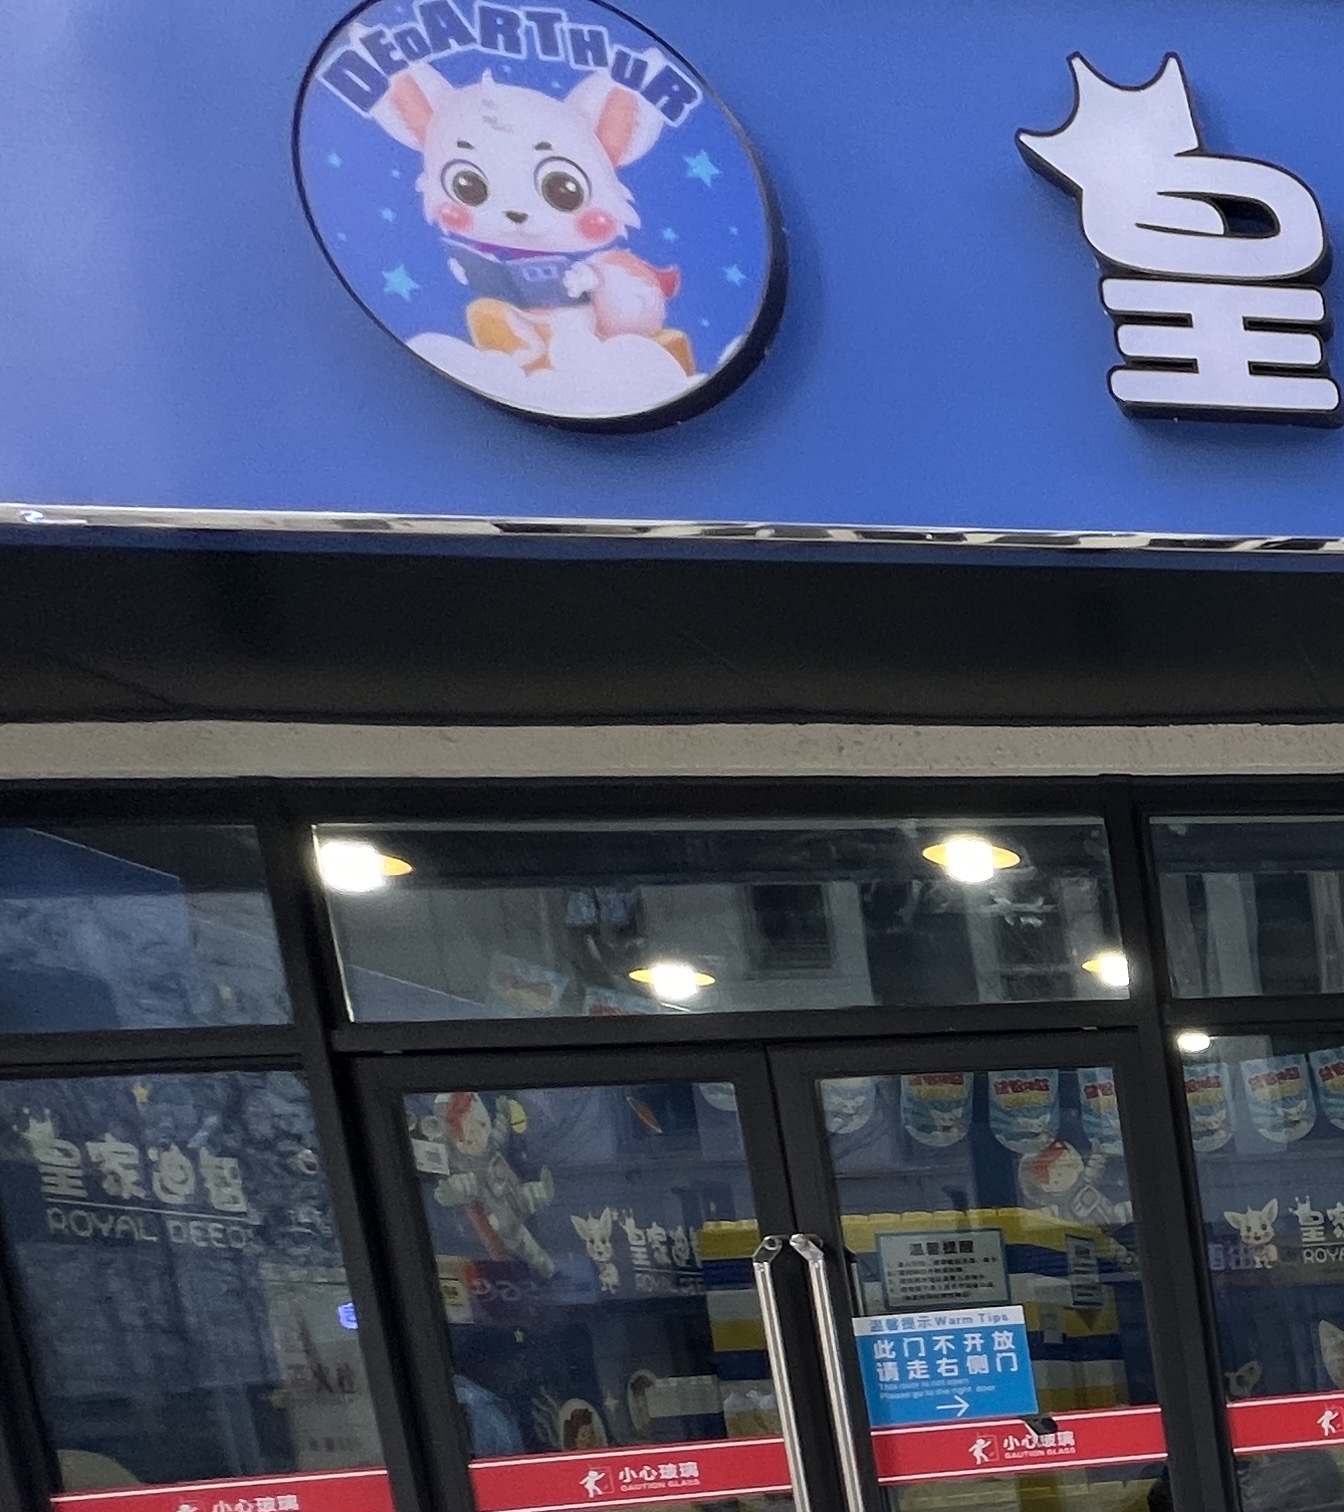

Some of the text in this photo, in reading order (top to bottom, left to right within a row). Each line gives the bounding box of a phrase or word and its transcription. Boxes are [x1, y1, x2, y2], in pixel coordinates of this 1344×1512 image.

[869, 1313, 1010, 1332] 温馨提示 Warm Tips
[873, 1330, 1016, 1360] 此门不开放
[875, 1352, 1019, 1383] 请走右侧门
[1003, 1430, 1076, 1451] 小心玻璃
[618, 1461, 700, 1483] 小心玻璃
